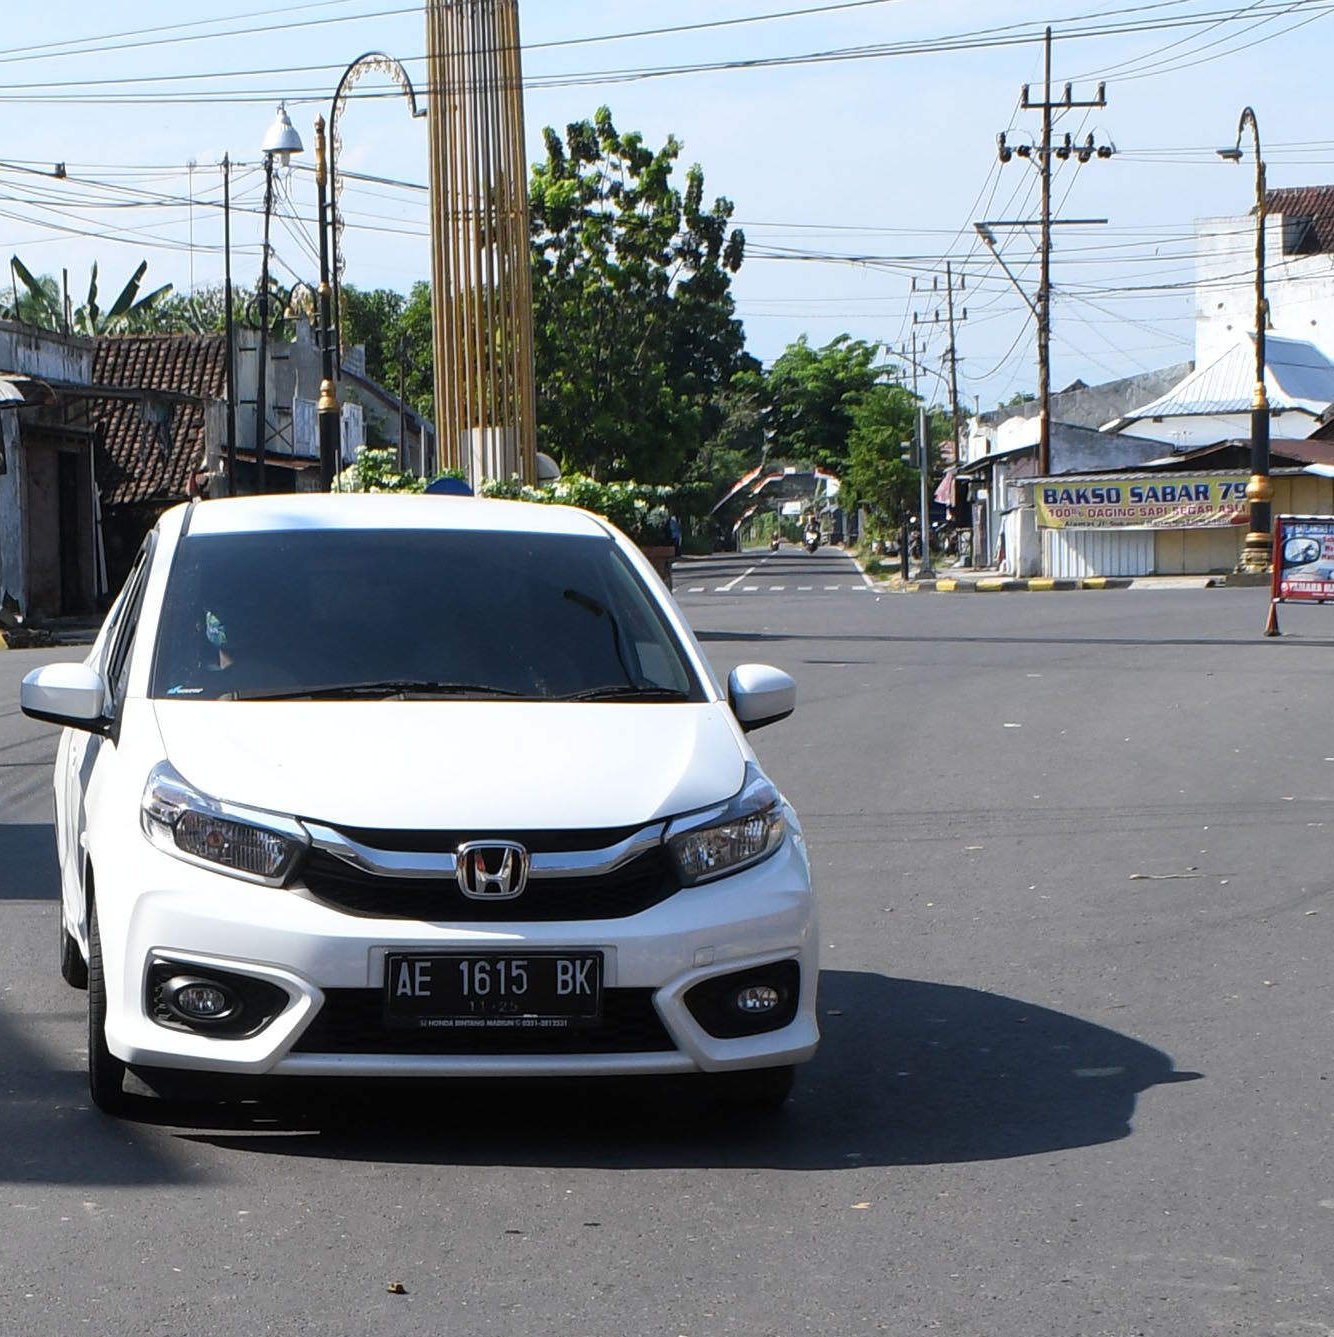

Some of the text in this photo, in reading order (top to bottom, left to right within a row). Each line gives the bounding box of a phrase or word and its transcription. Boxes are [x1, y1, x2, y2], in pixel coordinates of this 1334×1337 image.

[1043, 481, 1248, 505] BAKSO SABAR 79
[1087, 507, 1136, 518] DAGING
[1139, 507, 1167, 518] SAPI
[1172, 504, 1214, 516] SEGAR
[1217, 503, 1246, 514] ASLI
[396, 959, 594, 997] AE 1615 BK
